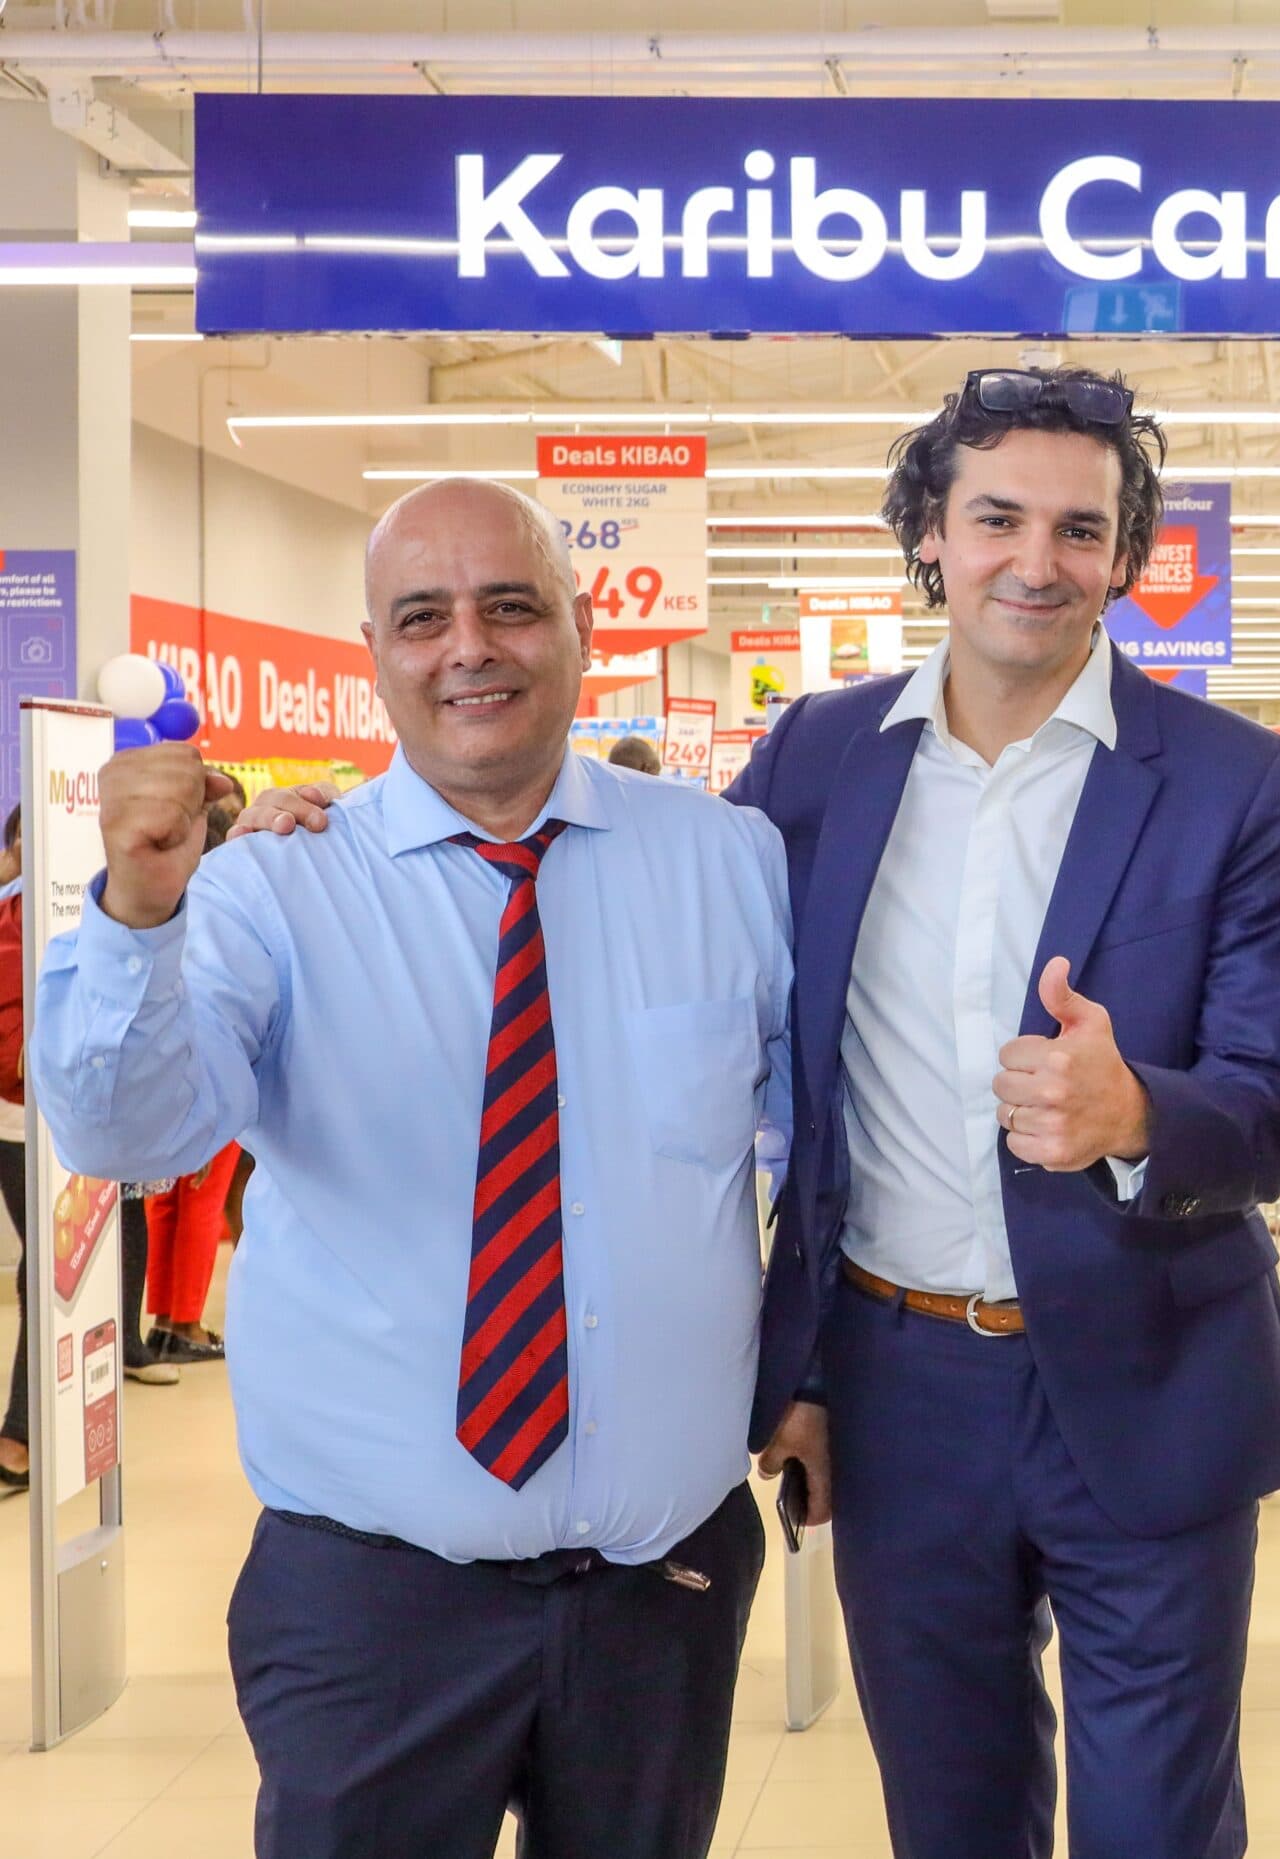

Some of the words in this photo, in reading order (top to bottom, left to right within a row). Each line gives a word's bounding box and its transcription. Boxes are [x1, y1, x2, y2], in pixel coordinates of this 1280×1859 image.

[455, 150, 986, 281] Karibu
[552, 445, 616, 466] Deals
[621, 445, 690, 466] KIBAO
[562, 483, 622, 495] ECONOMY
[625, 483, 667, 495] SUGAR
[582, 497, 623, 508] WHITE
[626, 497, 650, 508] 2KG
[574, 566, 663, 619] 49
[664, 595, 698, 611] KES
[773, 635, 800, 646] KIBA
[1143, 640, 1226, 657] SAVINGS
[259, 660, 331, 736] Deals
[668, 741, 707, 763] 249
